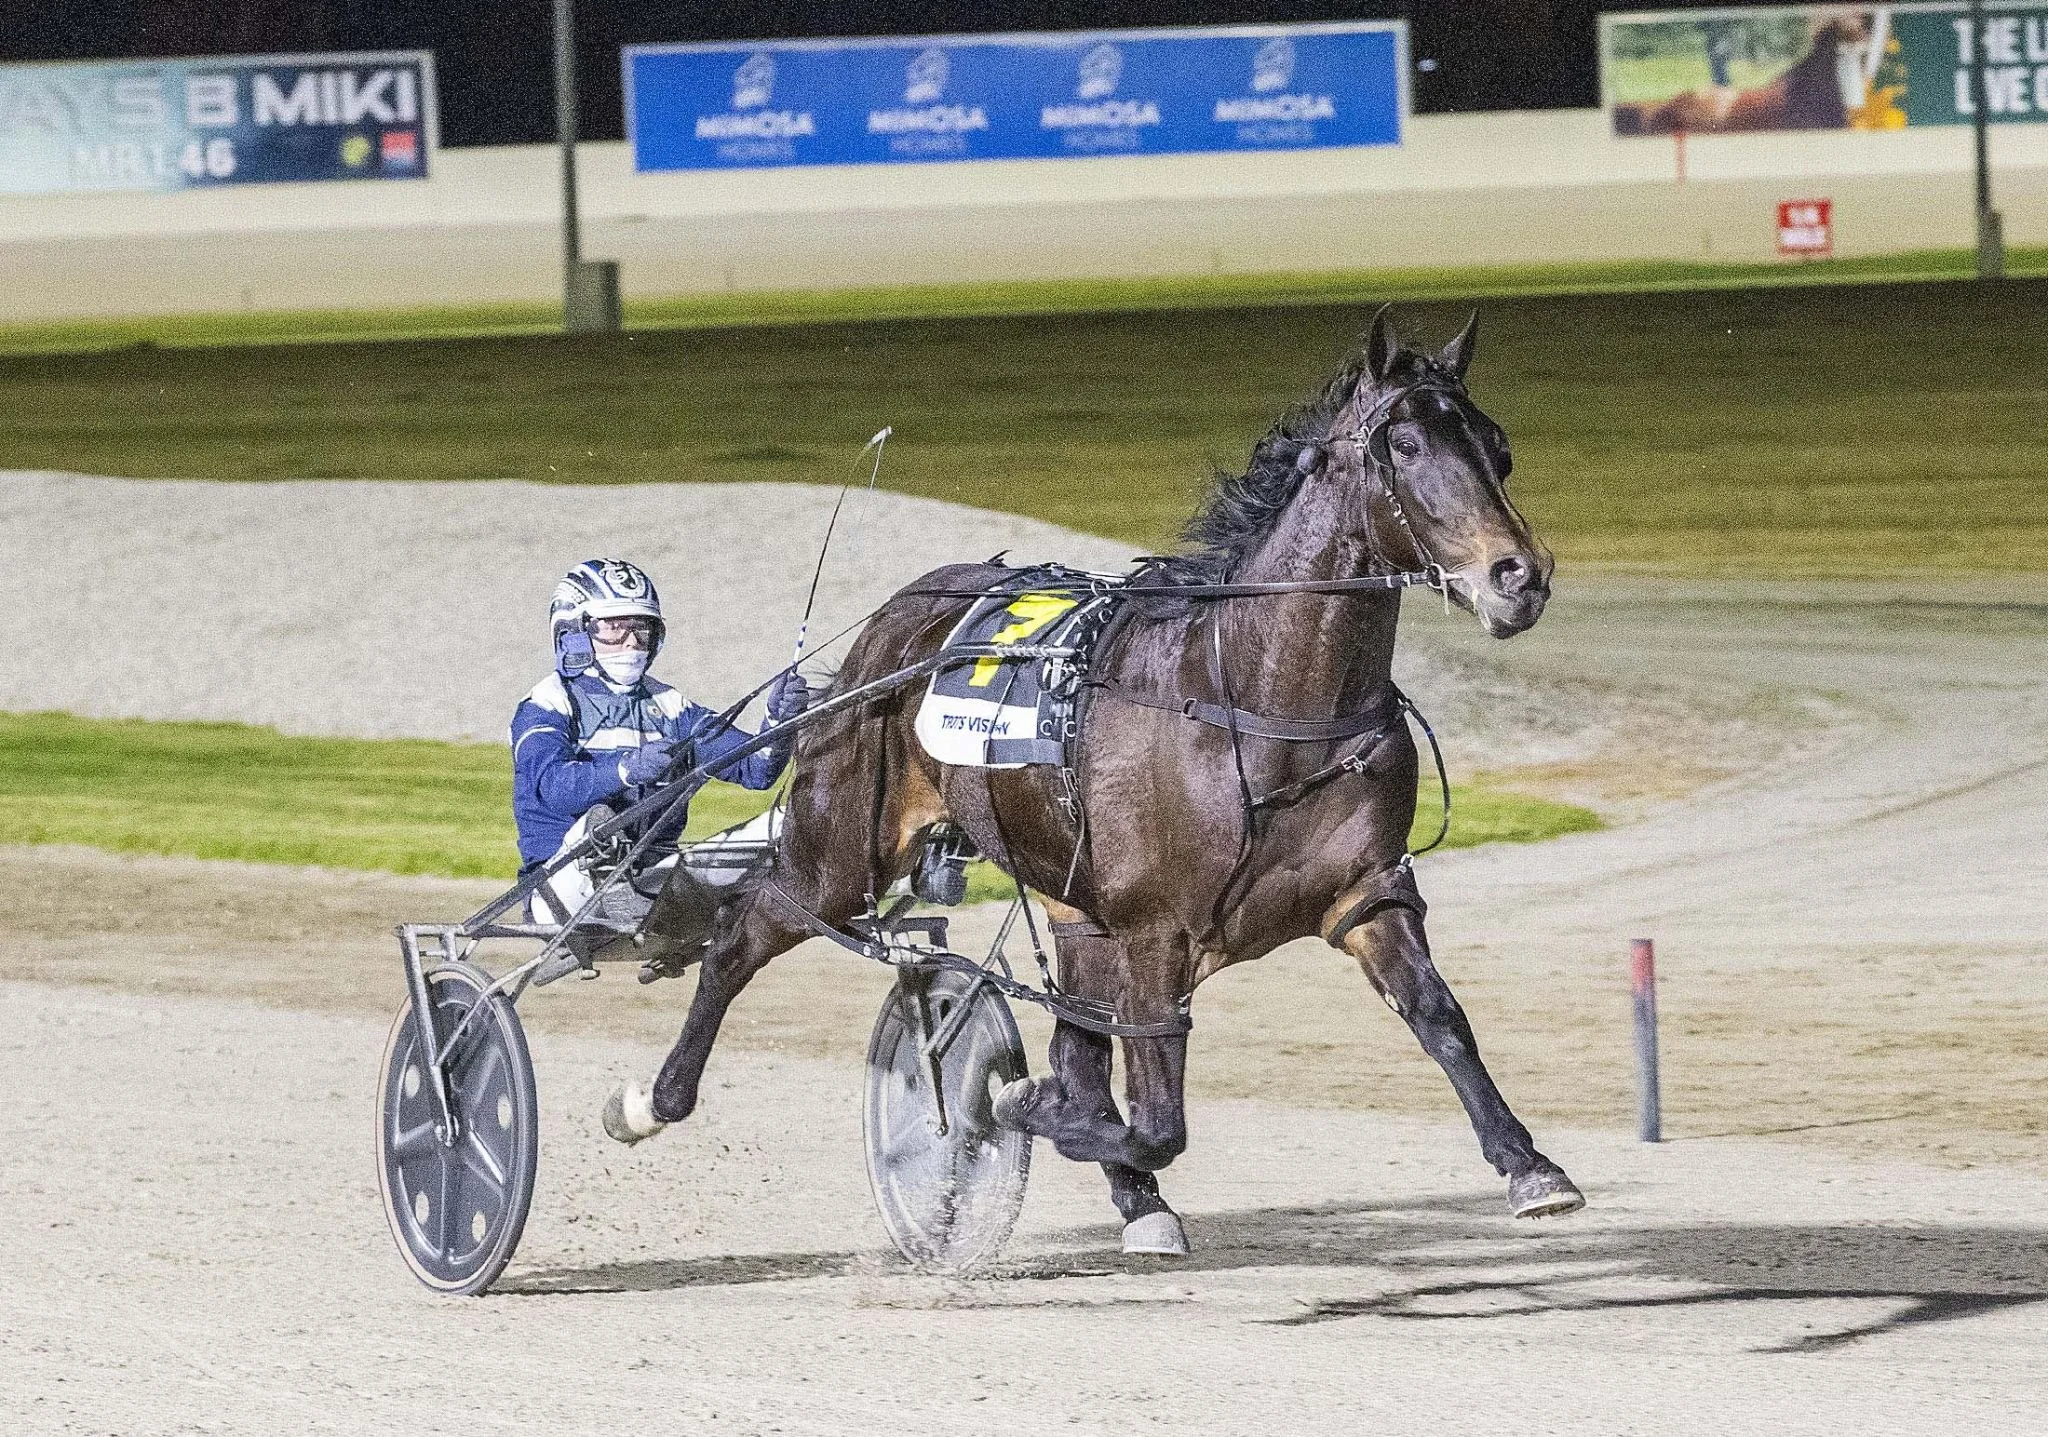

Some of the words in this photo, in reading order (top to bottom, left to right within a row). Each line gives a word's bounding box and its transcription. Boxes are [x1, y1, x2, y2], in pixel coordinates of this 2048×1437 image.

[184, 76, 238, 125] B
[252, 70, 418, 126] MIKI
[967, 589, 1079, 687] 7
